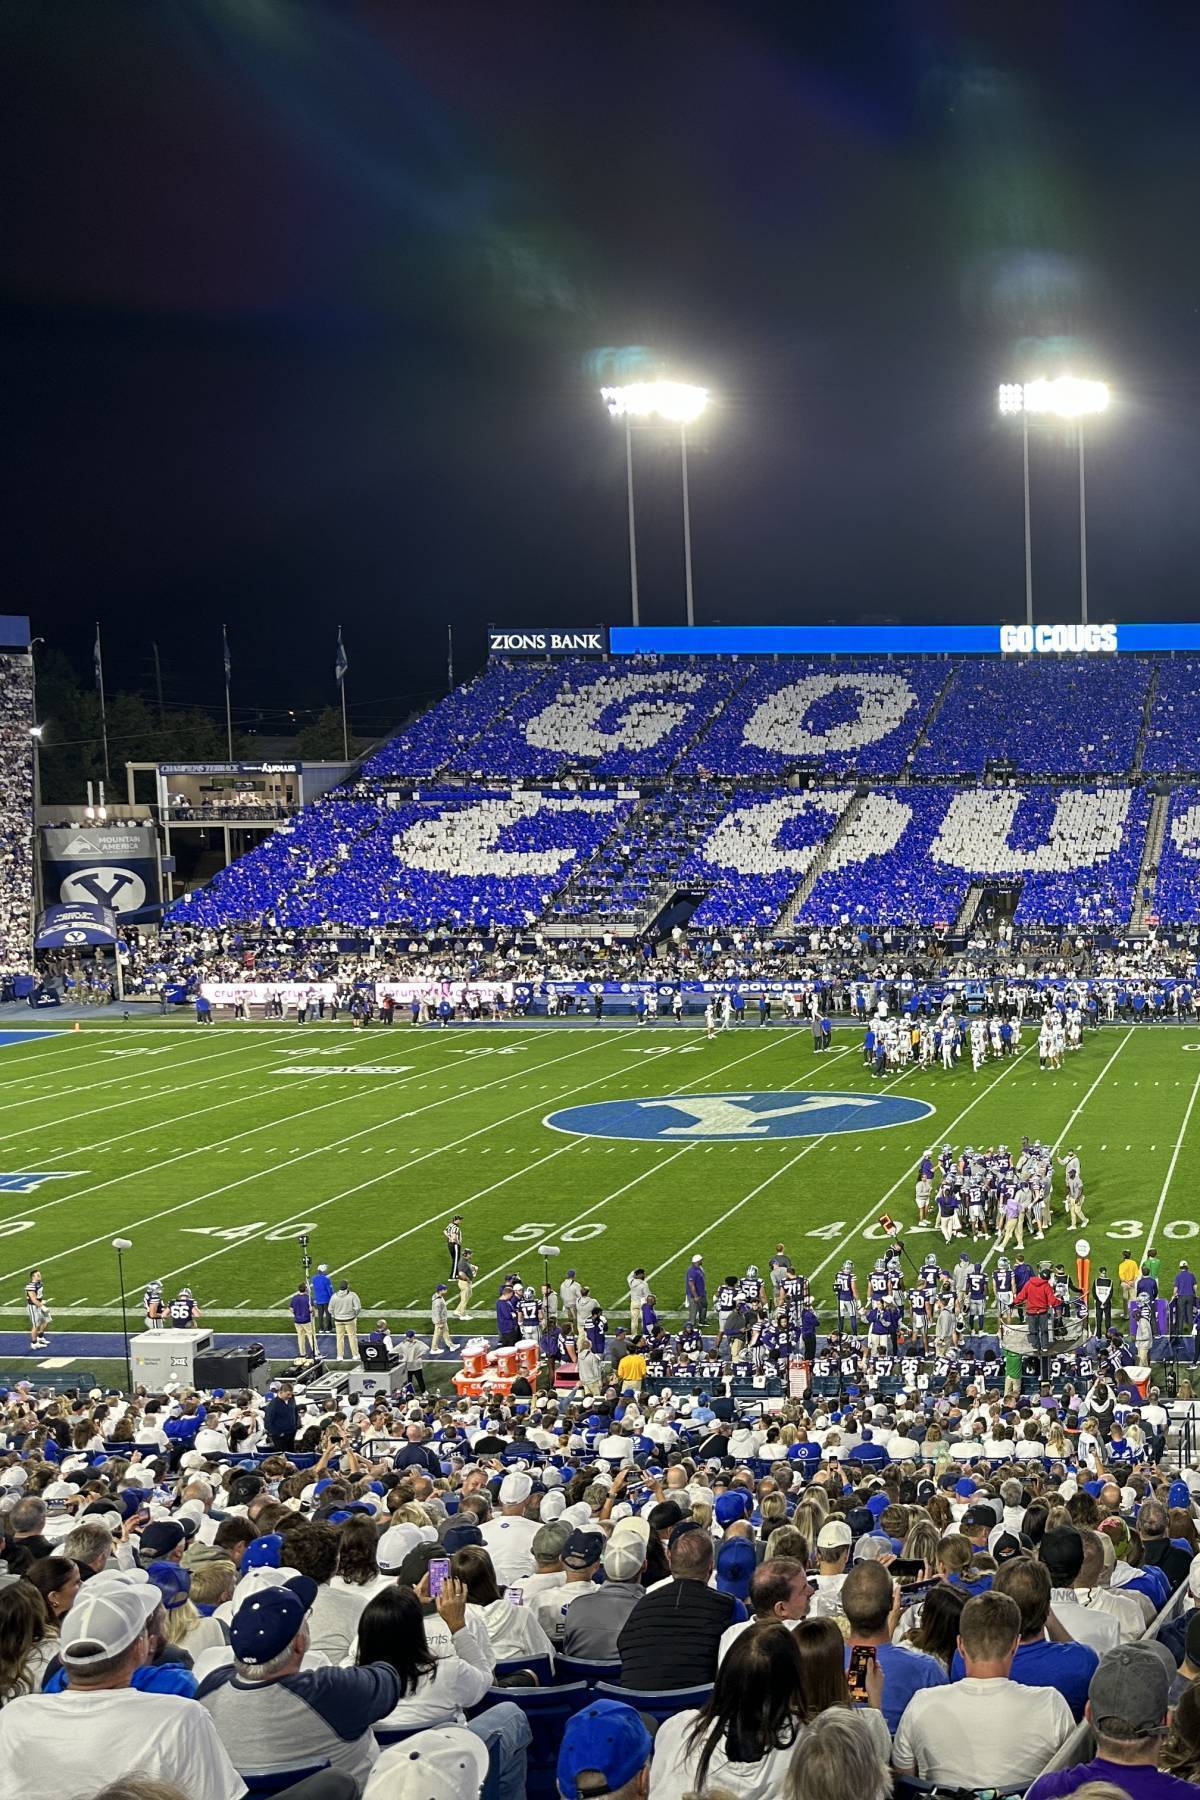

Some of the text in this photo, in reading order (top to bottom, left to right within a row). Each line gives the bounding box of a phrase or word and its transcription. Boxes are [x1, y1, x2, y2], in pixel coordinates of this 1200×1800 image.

[490, 634, 602, 649] ZIONS BANK
[1000, 624, 1117, 652] GO COUGS
[526, 671, 919, 757] GO
[99, 835, 140, 843] MOUNTAIN
[703, 983, 735, 992] BYU
[969, 1190, 981, 1203] 12
[211, 1222, 317, 1240] 40
[503, 1222, 607, 1242] 50
[804, 1221, 903, 1240] 40
[1106, 1220, 1200, 1240] 30
[926, 1272, 934, 1284] 4
[971, 1278, 980, 1291] 5
[997, 1277, 1006, 1289] 7
[721, 1293, 733, 1306] 91
[910, 1295, 924, 1309] 30
[170, 1305, 190, 1319] 66
[521, 1306, 536, 1319] 17
[683, 1339, 697, 1351] 44
[778, 1333, 788, 1345] 2
[464, 1359, 472, 1367] G
[813, 1362, 830, 1377] 45
[841, 1360, 855, 1376] 41
[875, 1361, 893, 1376] 57
[960, 1363, 969, 1377] 2
[1080, 1360, 1092, 1376] 21
[702, 1366, 720, 1378] 47
[983, 1364, 1000, 1377] 27
